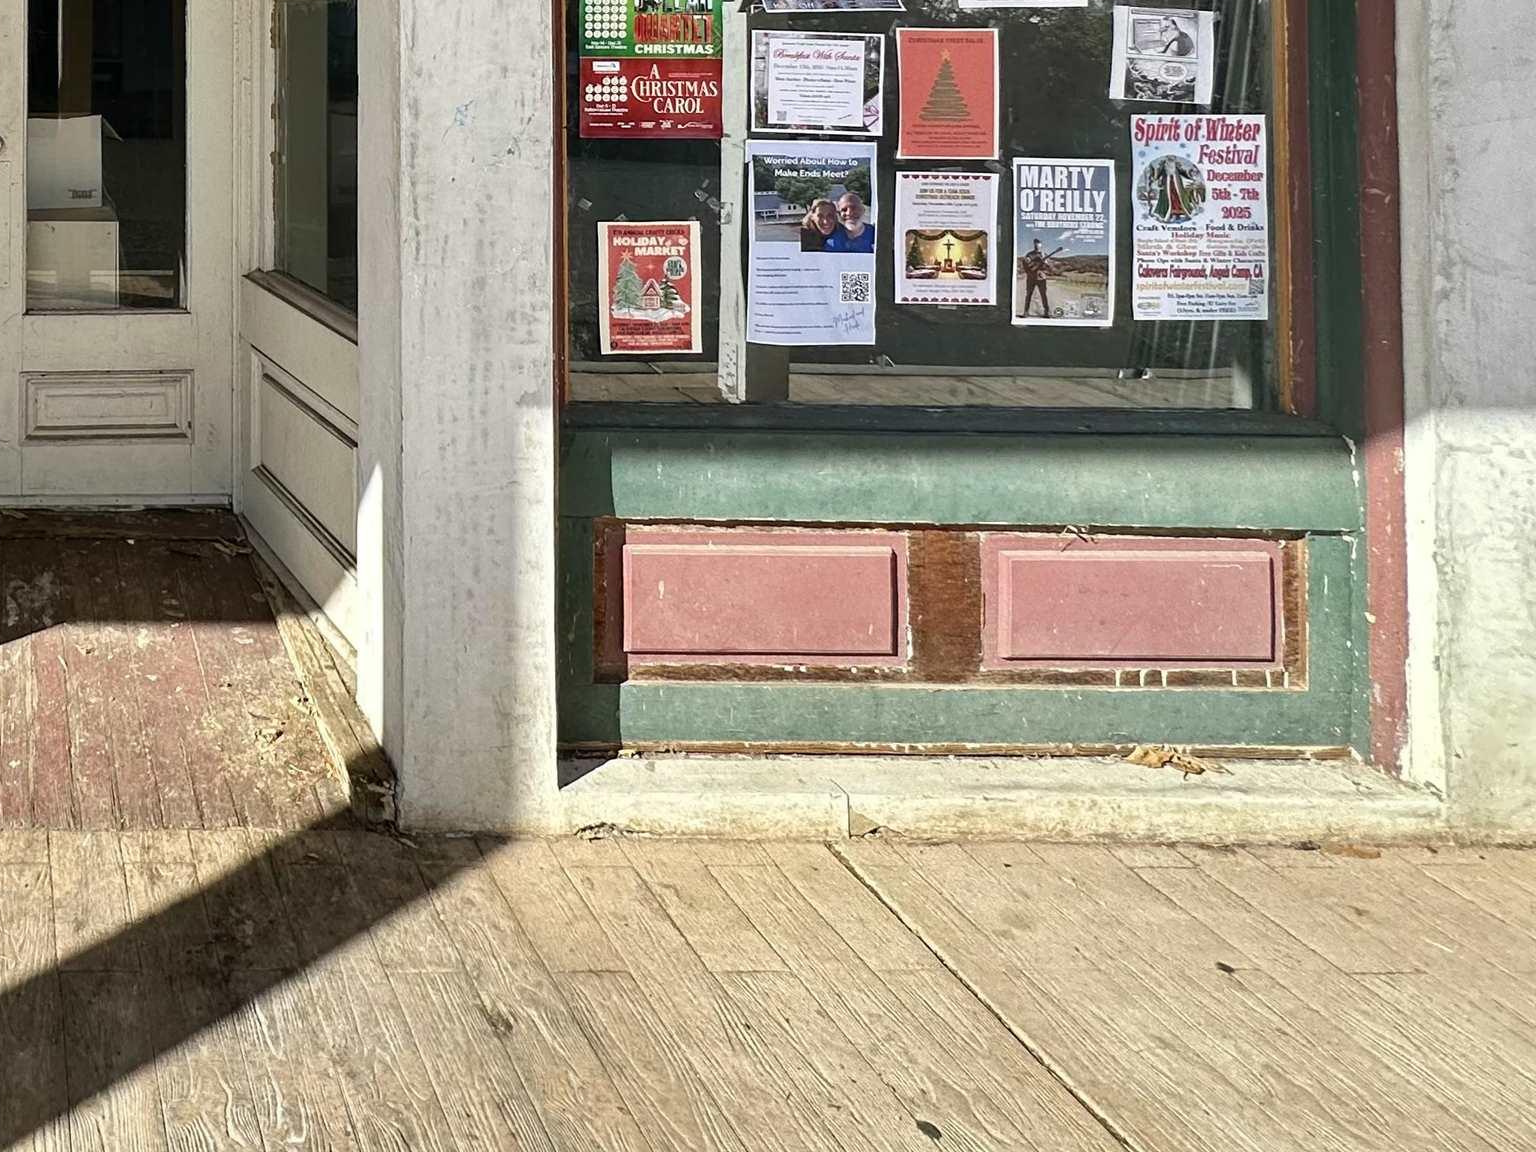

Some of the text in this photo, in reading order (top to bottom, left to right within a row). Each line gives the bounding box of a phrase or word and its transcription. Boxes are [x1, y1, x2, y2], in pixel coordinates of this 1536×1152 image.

[635, 44, 713, 55] CHRISTMAS
[649, 64, 661, 79] A
[631, 75, 718, 102] CHRISTMAS
[653, 97, 704, 114] CAROL
[1134, 117, 1261, 147] Spirit of Winter
[764, 156, 858, 167] Worried About How to
[1197, 144, 1260, 166] Festival
[774, 169, 849, 178] Make Ends Meet?
[1020, 166, 1095, 189] MARTY
[1206, 169, 1264, 182] December
[1020, 188, 1106, 213] O'REILLY
[1211, 188, 1260, 201] 5th 7th
[1221, 206, 1252, 219] 2025
[1136, 224, 1159, 232] Craft
[1205, 224, 1227, 232] Food
[1228, 224, 1236, 232] &
[1237, 224, 1264, 232] Drinks
[612, 237, 665, 246] HOLIDAY
[634, 247, 686, 256] MARKET
